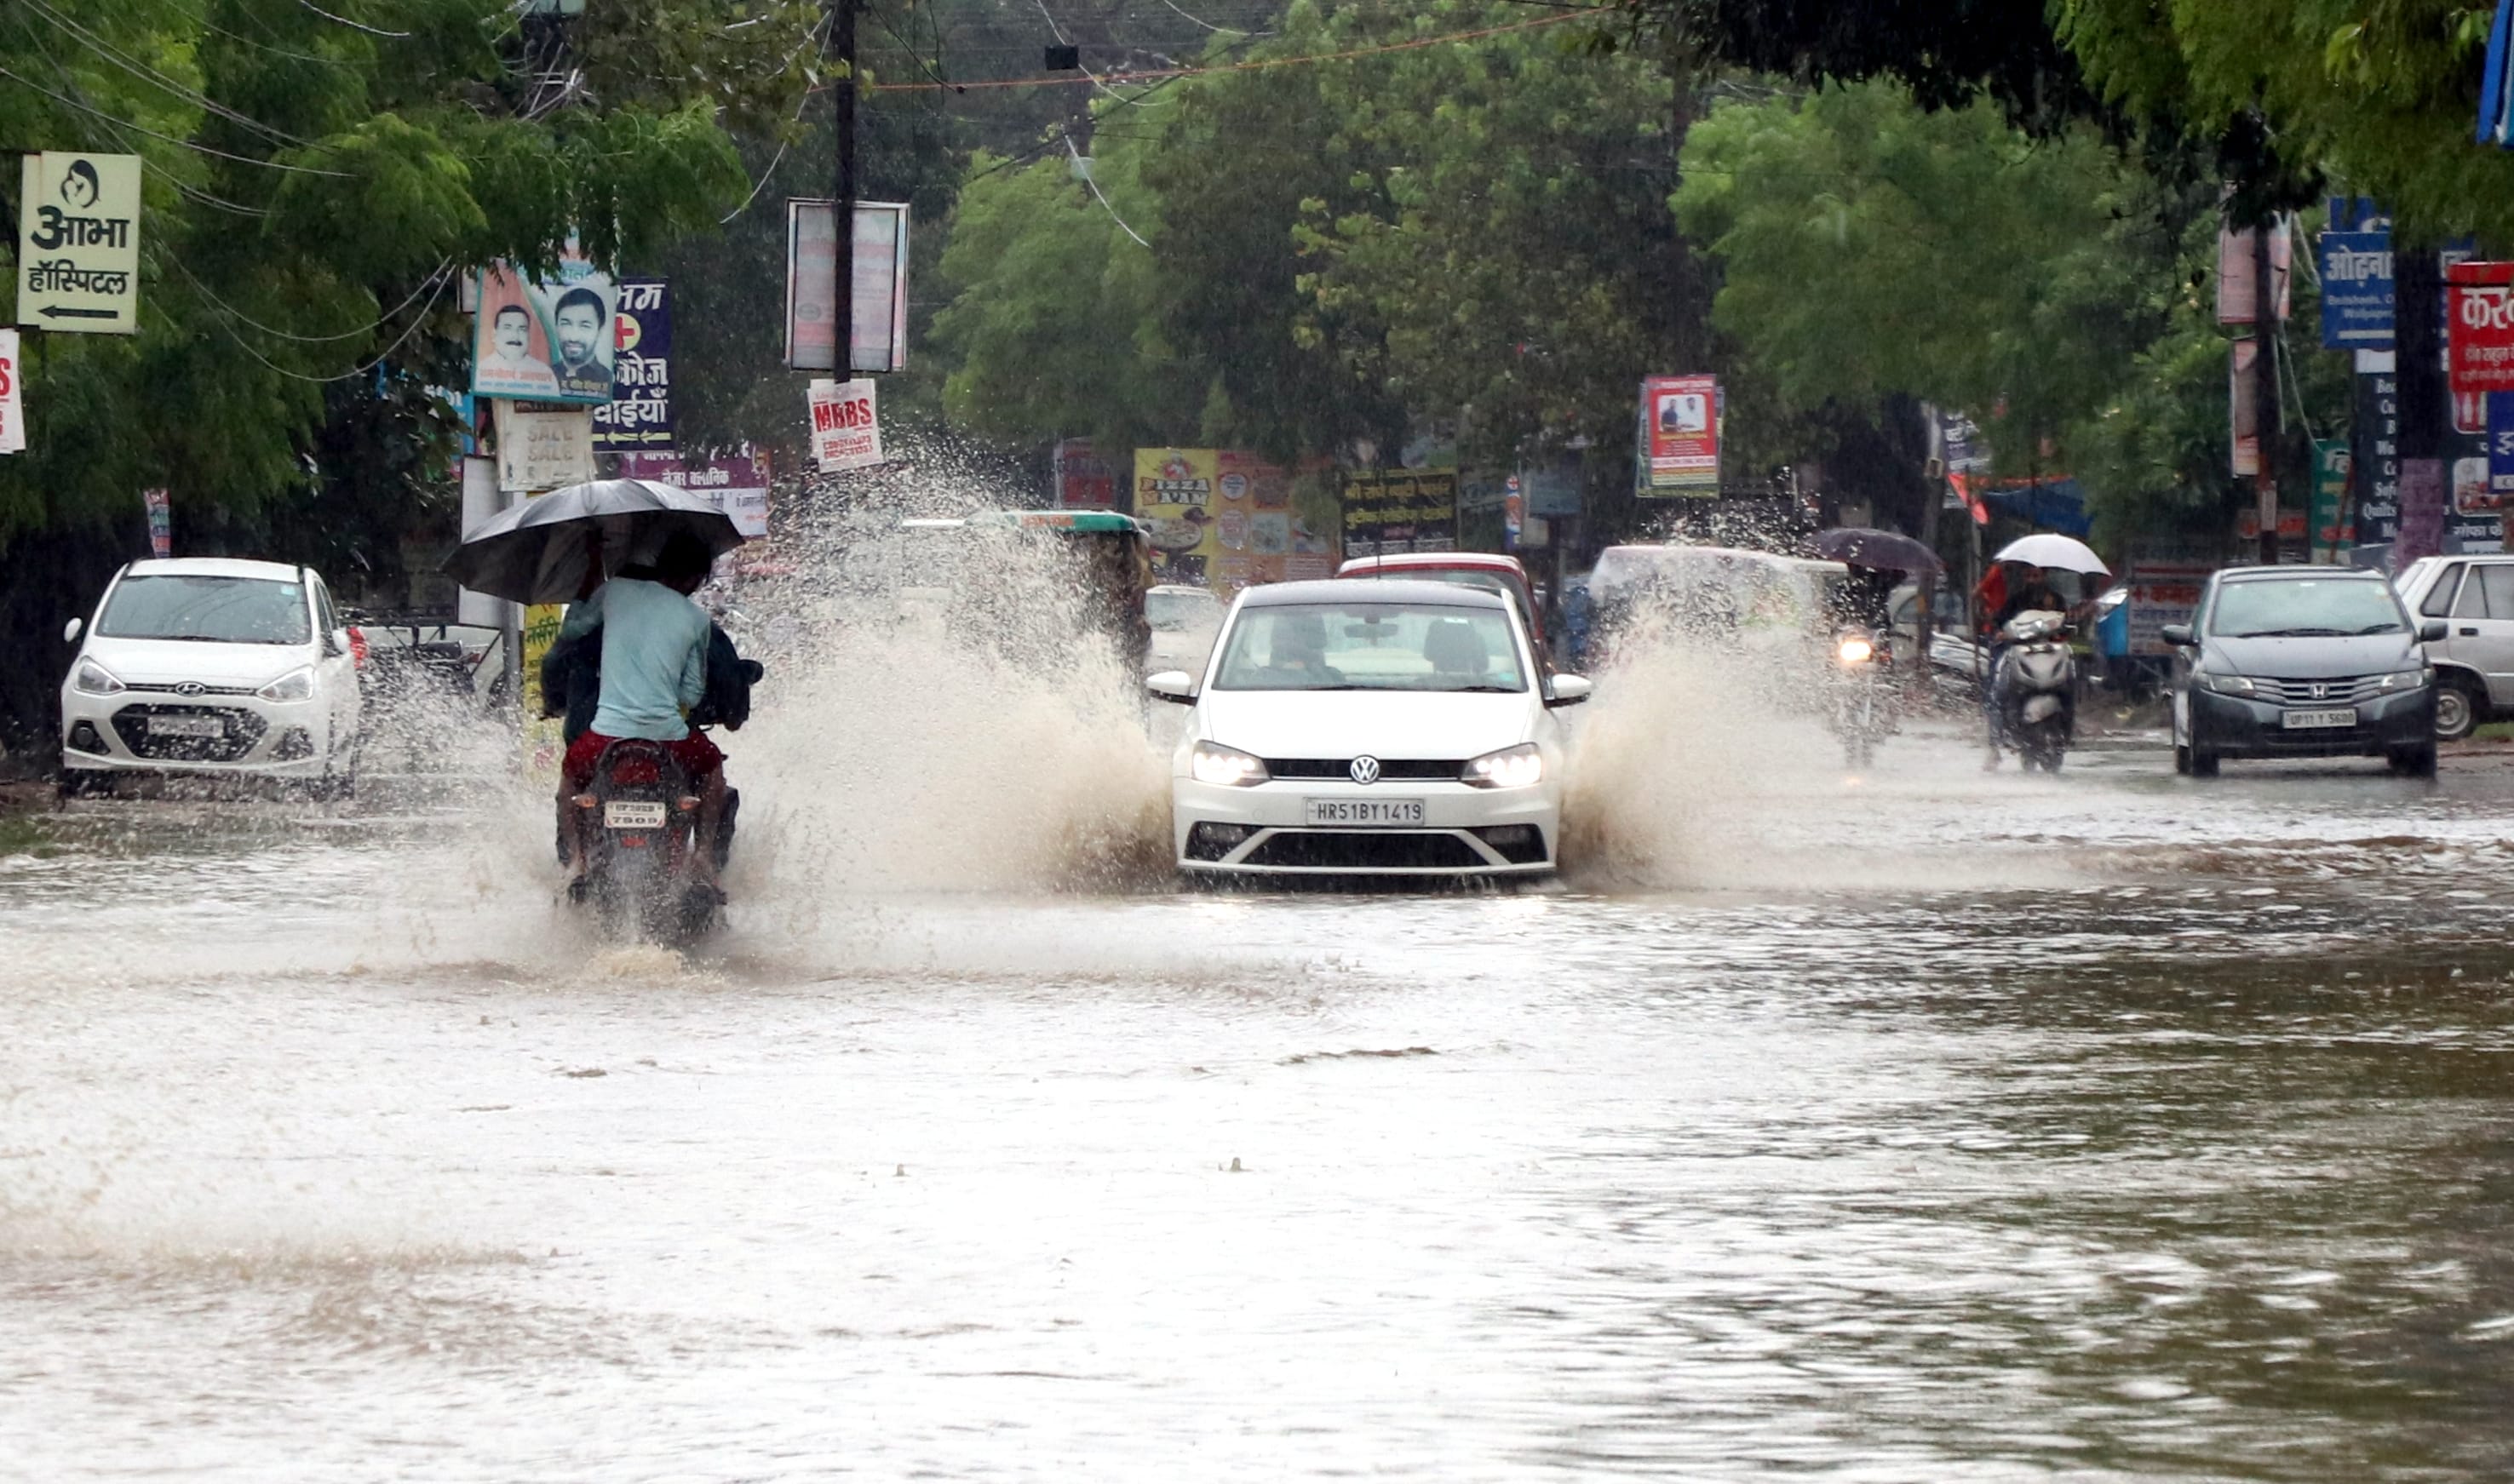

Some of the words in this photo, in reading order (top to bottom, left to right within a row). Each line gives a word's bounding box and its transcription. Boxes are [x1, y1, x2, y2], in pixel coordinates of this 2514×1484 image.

[31, 205, 130, 250] आभा
[27, 259, 129, 295] हॉस्पिटल
[813, 398, 872, 433] MBBS
[1317, 803, 1421, 820] HR51BY1419
